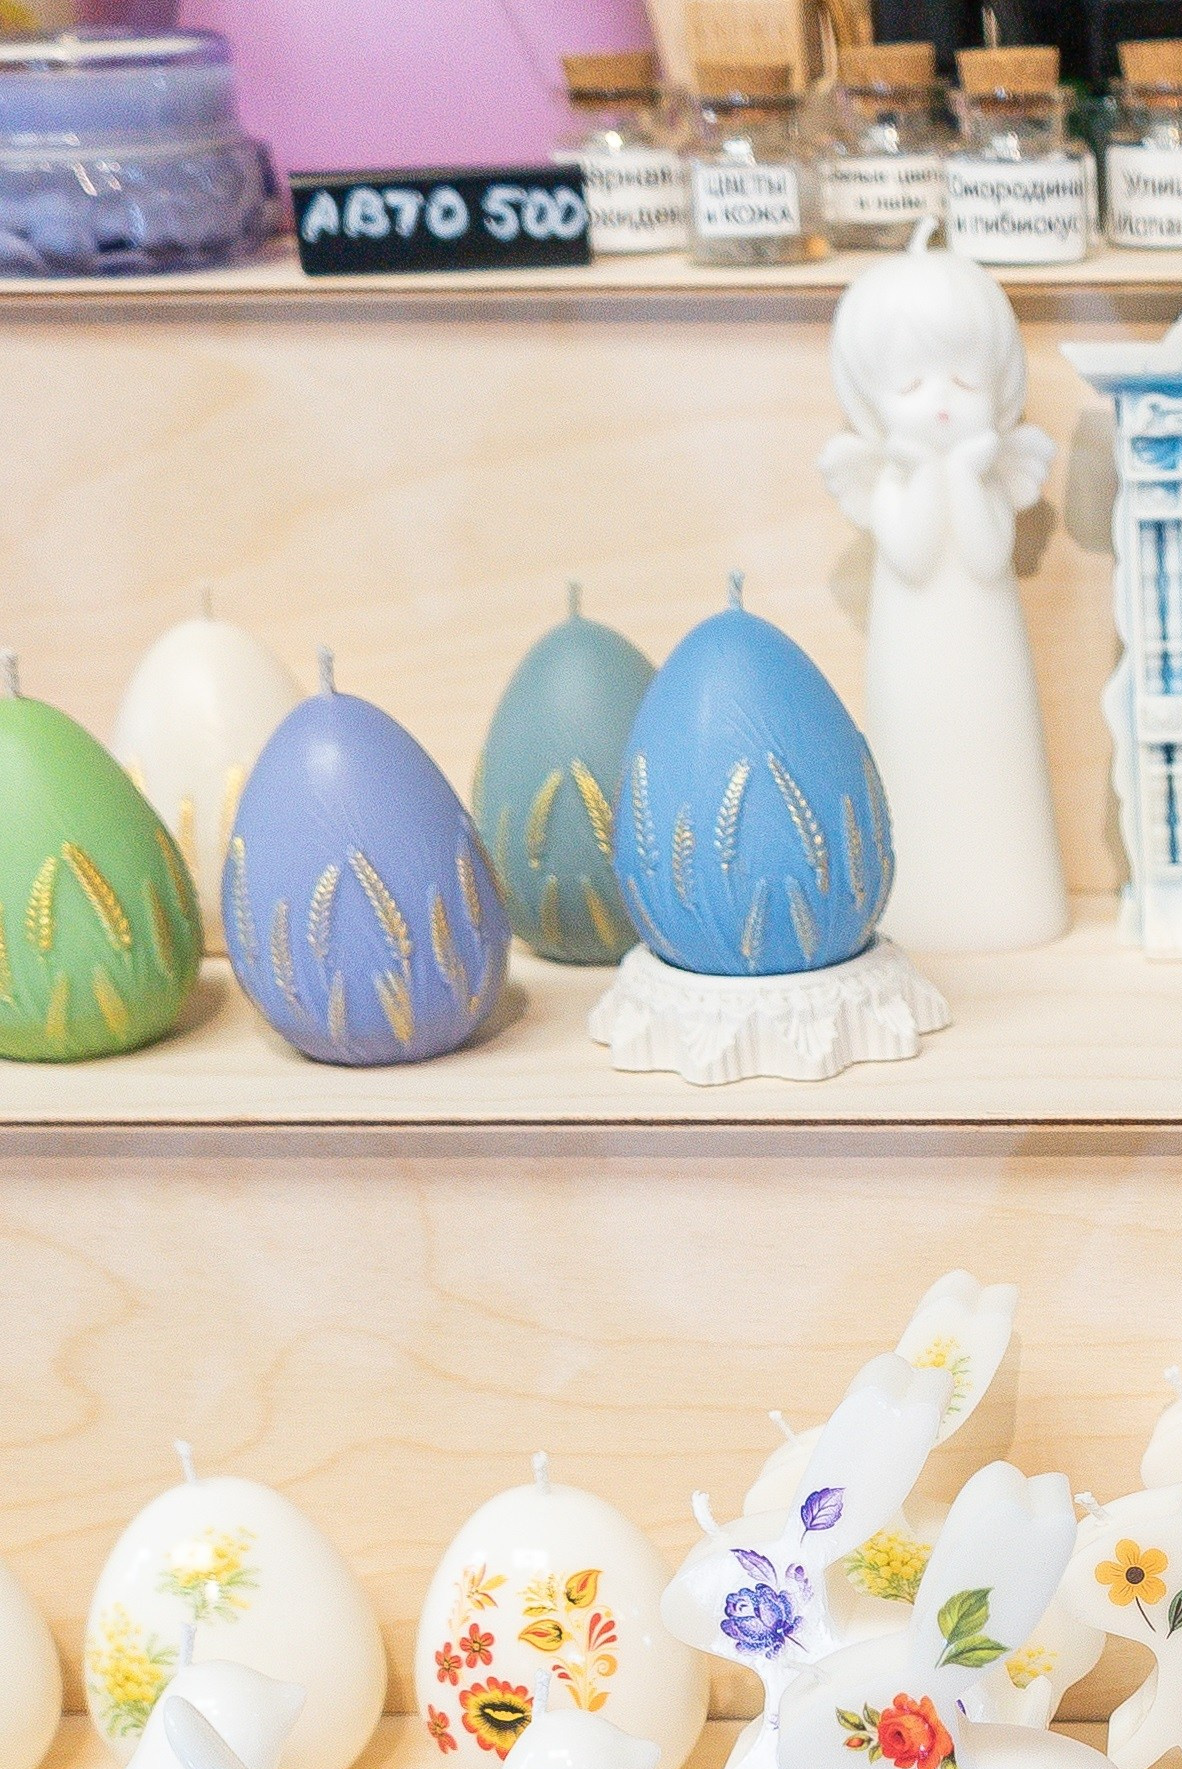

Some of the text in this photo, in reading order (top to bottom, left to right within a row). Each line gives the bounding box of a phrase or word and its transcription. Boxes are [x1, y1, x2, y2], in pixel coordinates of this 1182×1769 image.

[706, 172, 788, 198] ЦВЕТЫ
[302, 182, 590, 244] АВТО 500
